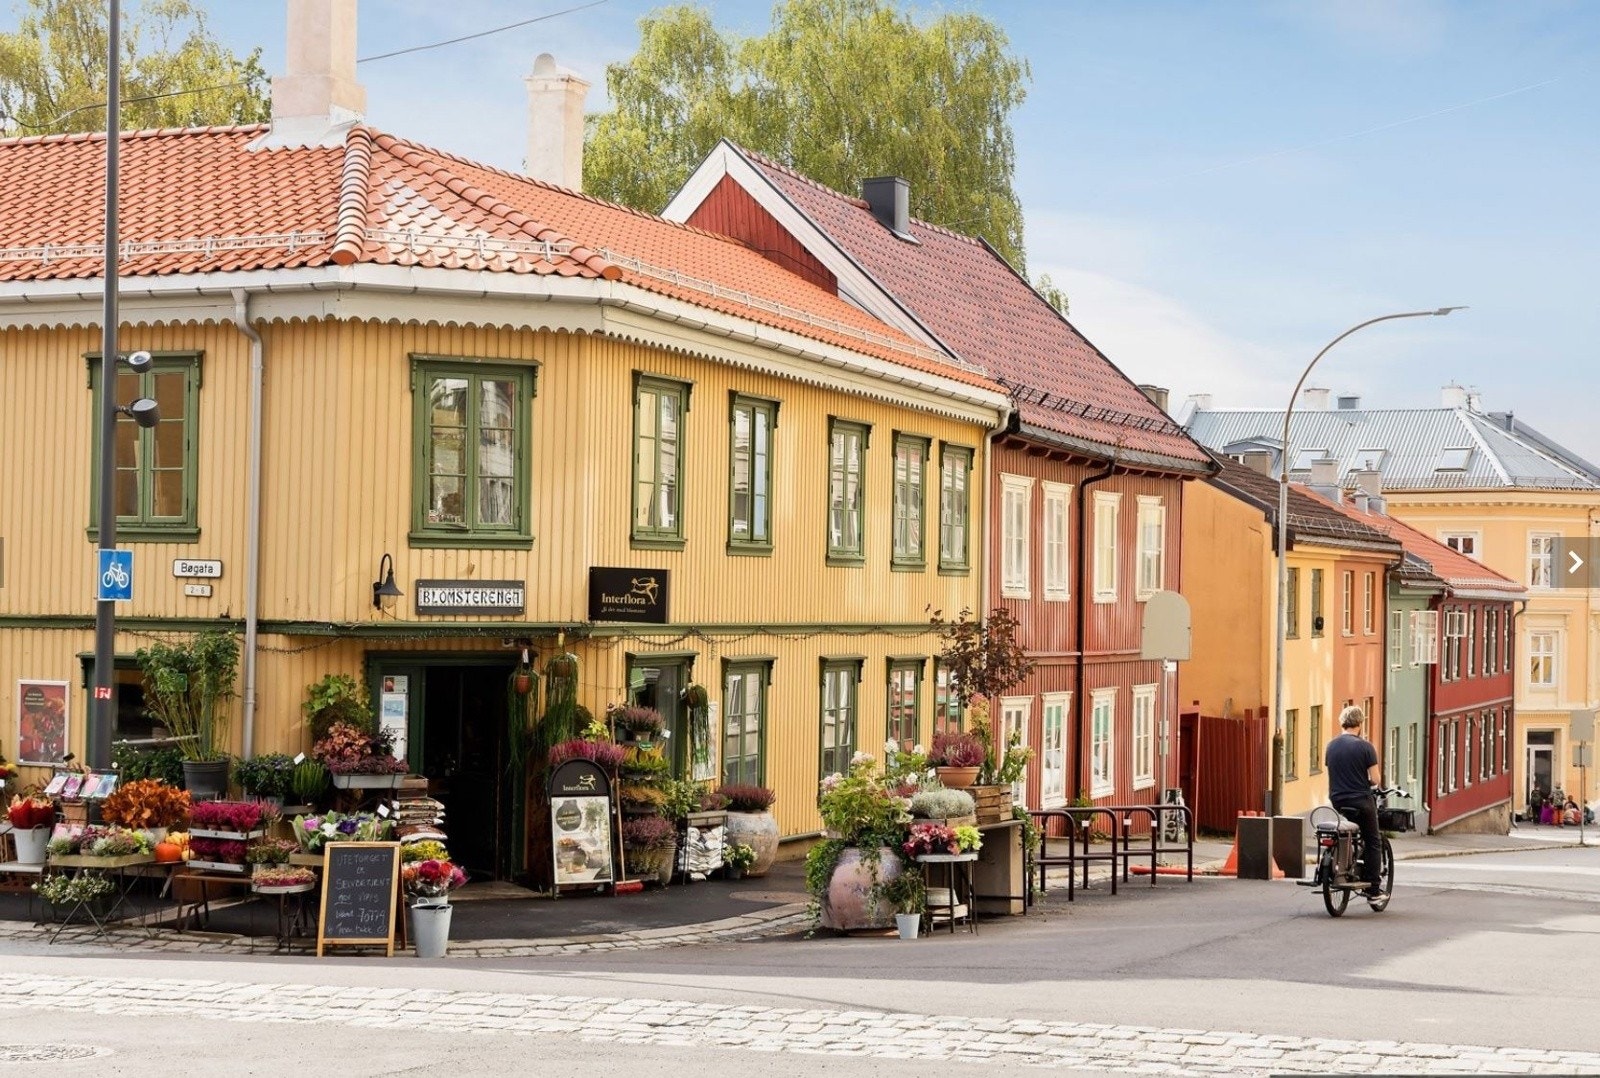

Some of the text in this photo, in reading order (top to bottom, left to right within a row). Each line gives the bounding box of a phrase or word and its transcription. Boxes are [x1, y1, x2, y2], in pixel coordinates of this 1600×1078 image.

[181, 562, 214, 576] Bøgata
[423, 590, 520, 604] BLOMSTERENGA
[601, 592, 646, 605] Interflora
